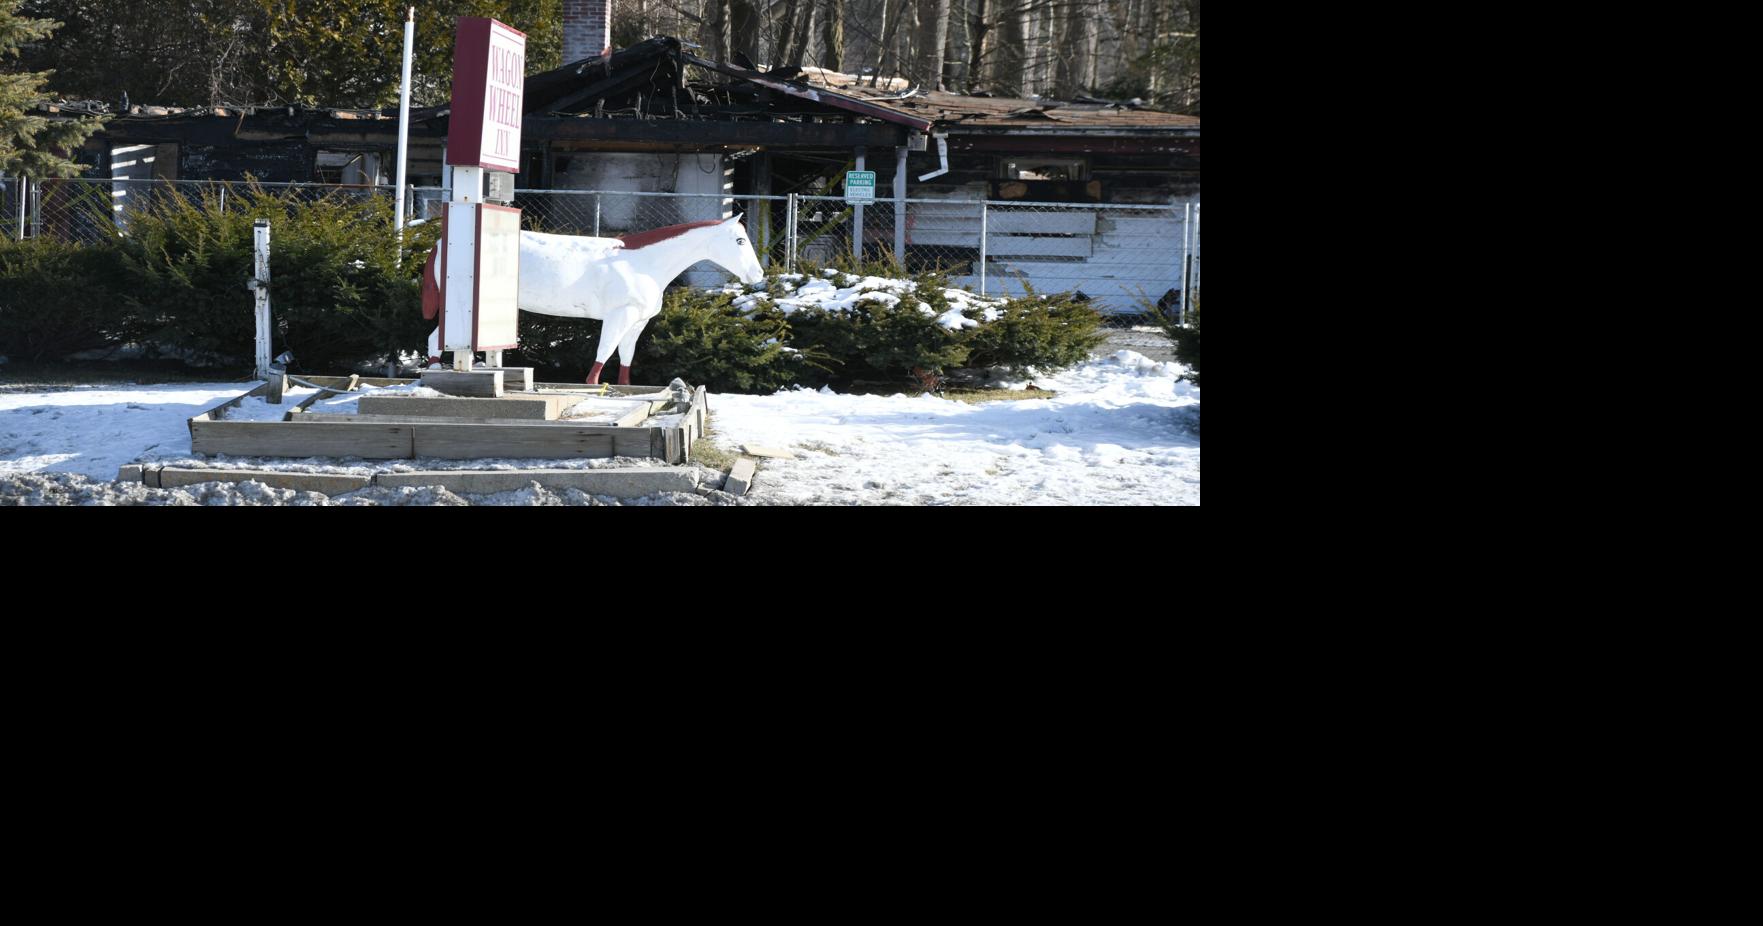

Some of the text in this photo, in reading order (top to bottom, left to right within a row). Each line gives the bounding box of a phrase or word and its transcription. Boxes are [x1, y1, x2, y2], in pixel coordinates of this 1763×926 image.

[492, 45, 523, 90] WAGON
[489, 85, 520, 129] WHEEL
[495, 128, 511, 156] INN
